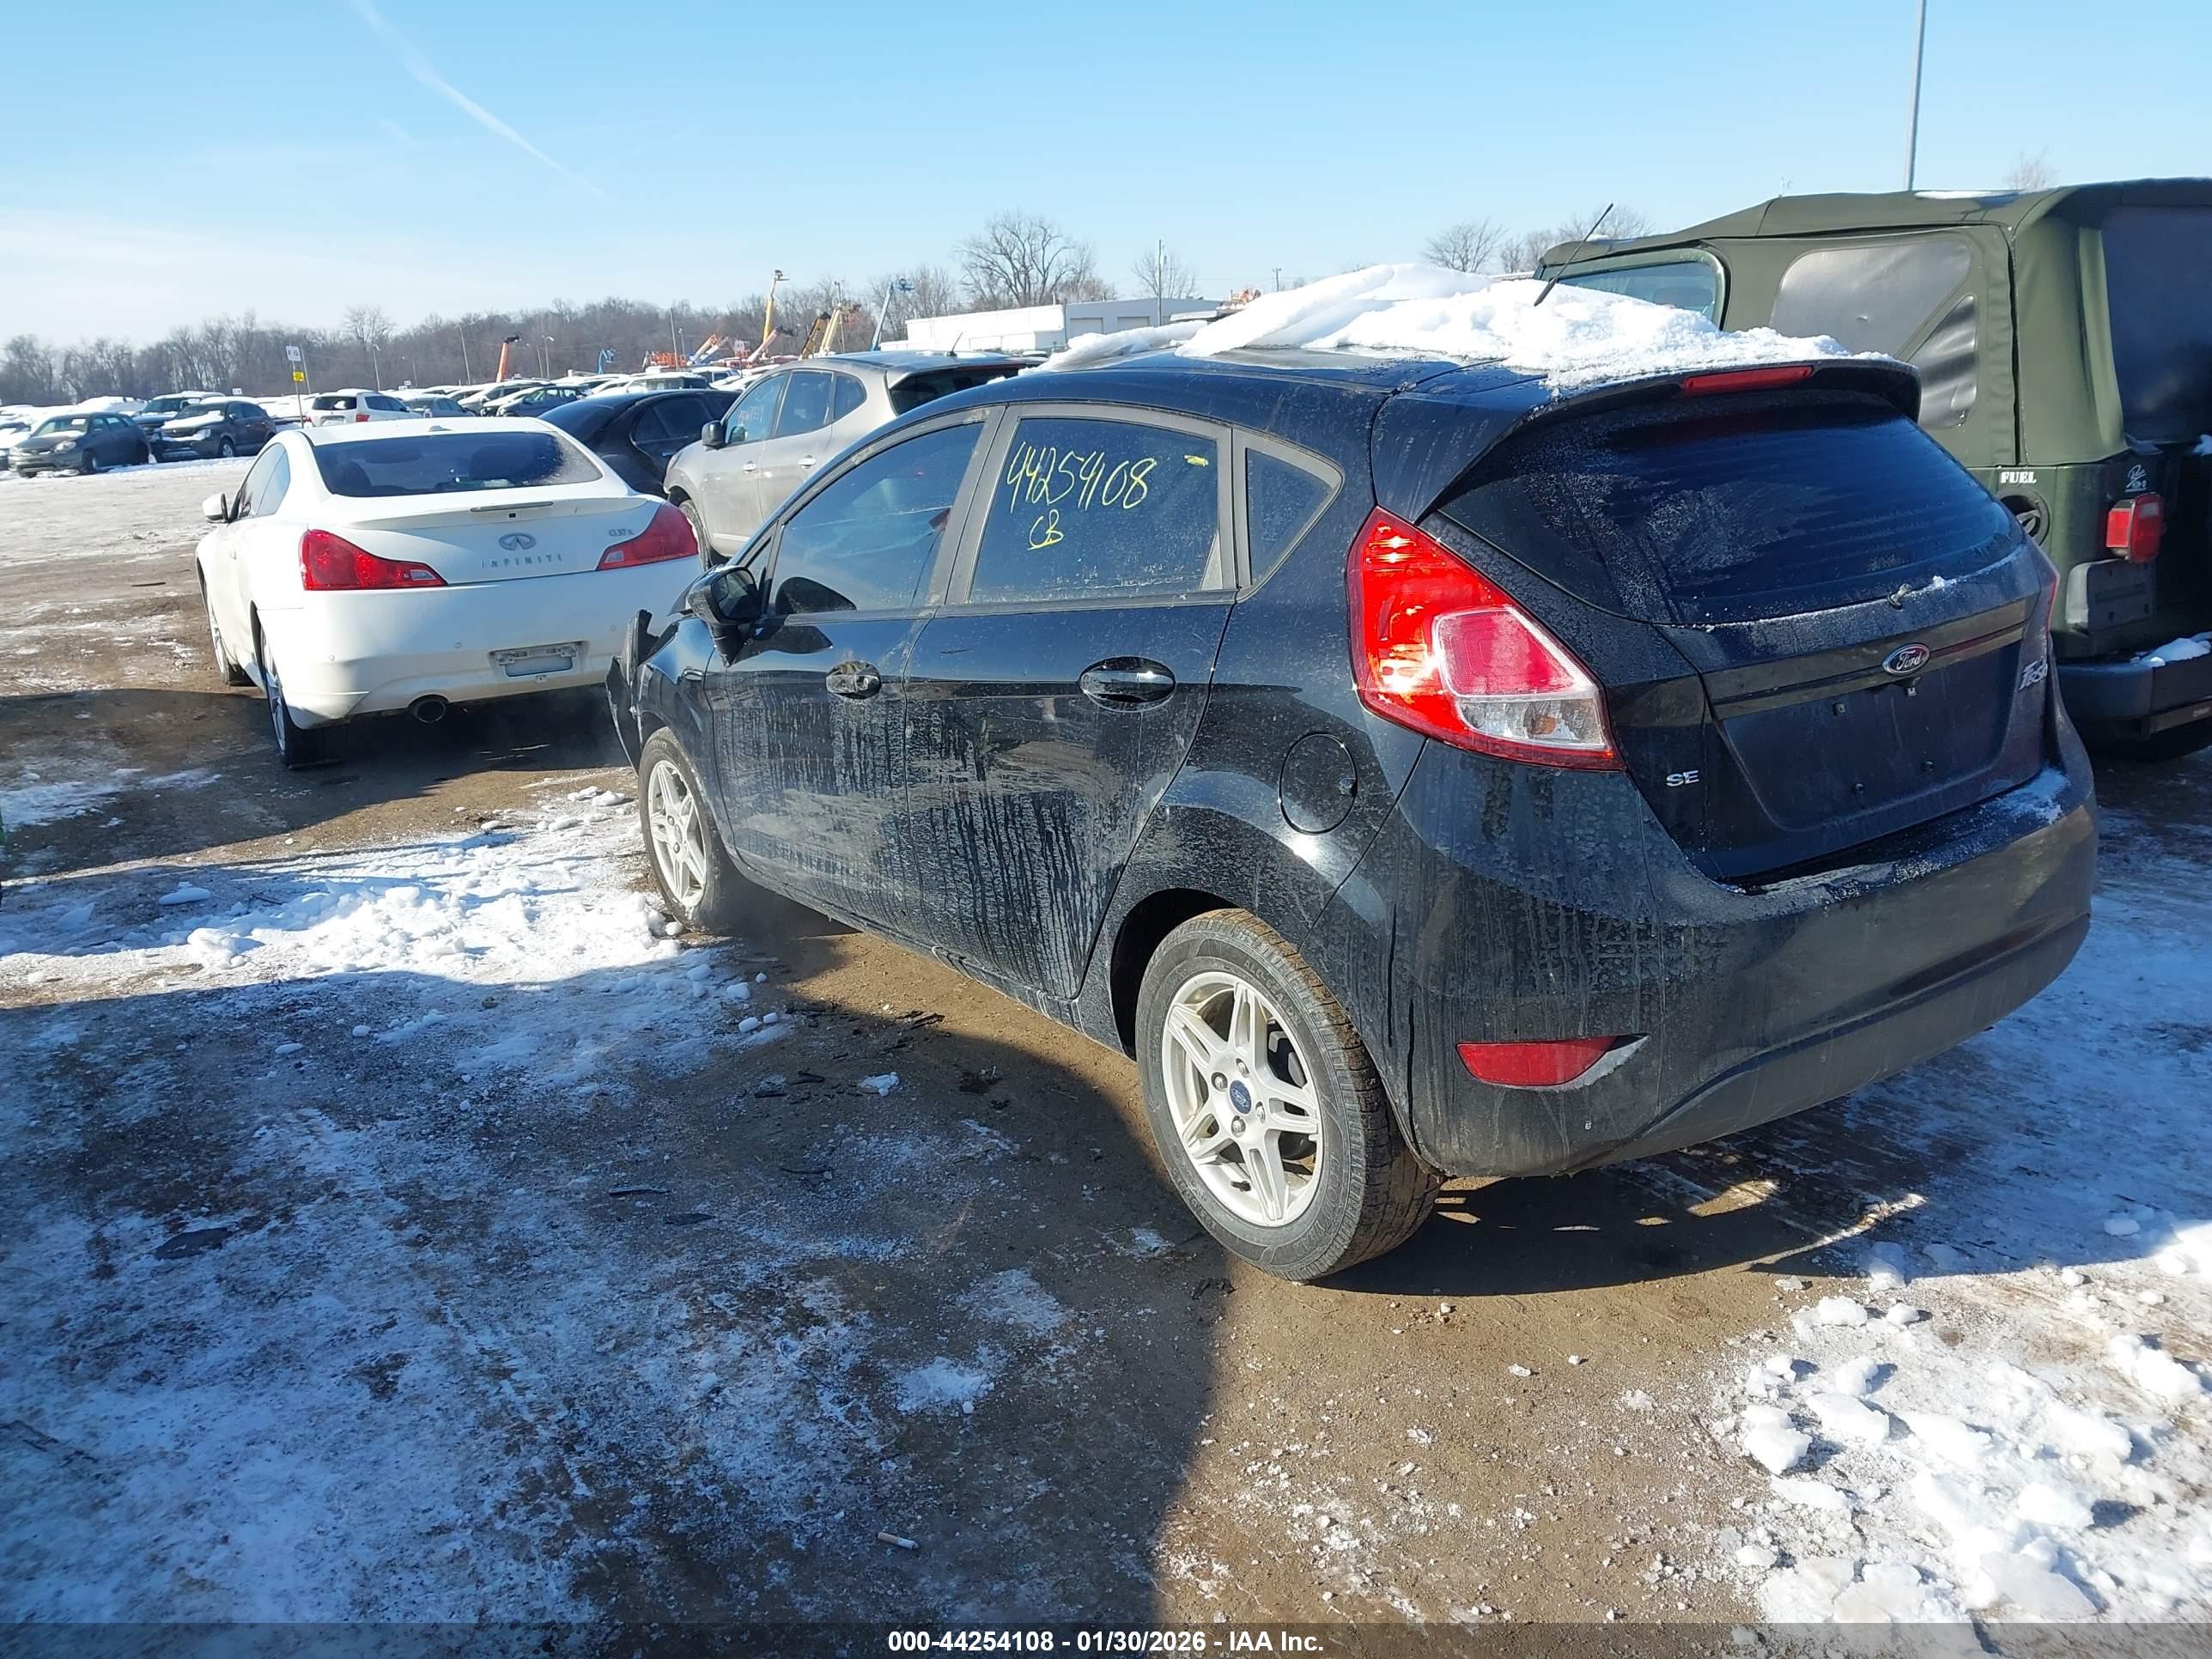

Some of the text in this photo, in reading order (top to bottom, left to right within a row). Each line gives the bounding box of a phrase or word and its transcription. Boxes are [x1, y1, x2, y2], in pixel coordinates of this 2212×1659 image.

[1006, 441, 1158, 514] 44254108
[1999, 471, 2038, 484] FUEL
[480, 553, 562, 568] INFINITI
[1896, 649, 1923, 670] Ford
[1666, 769, 1700, 787] SE
